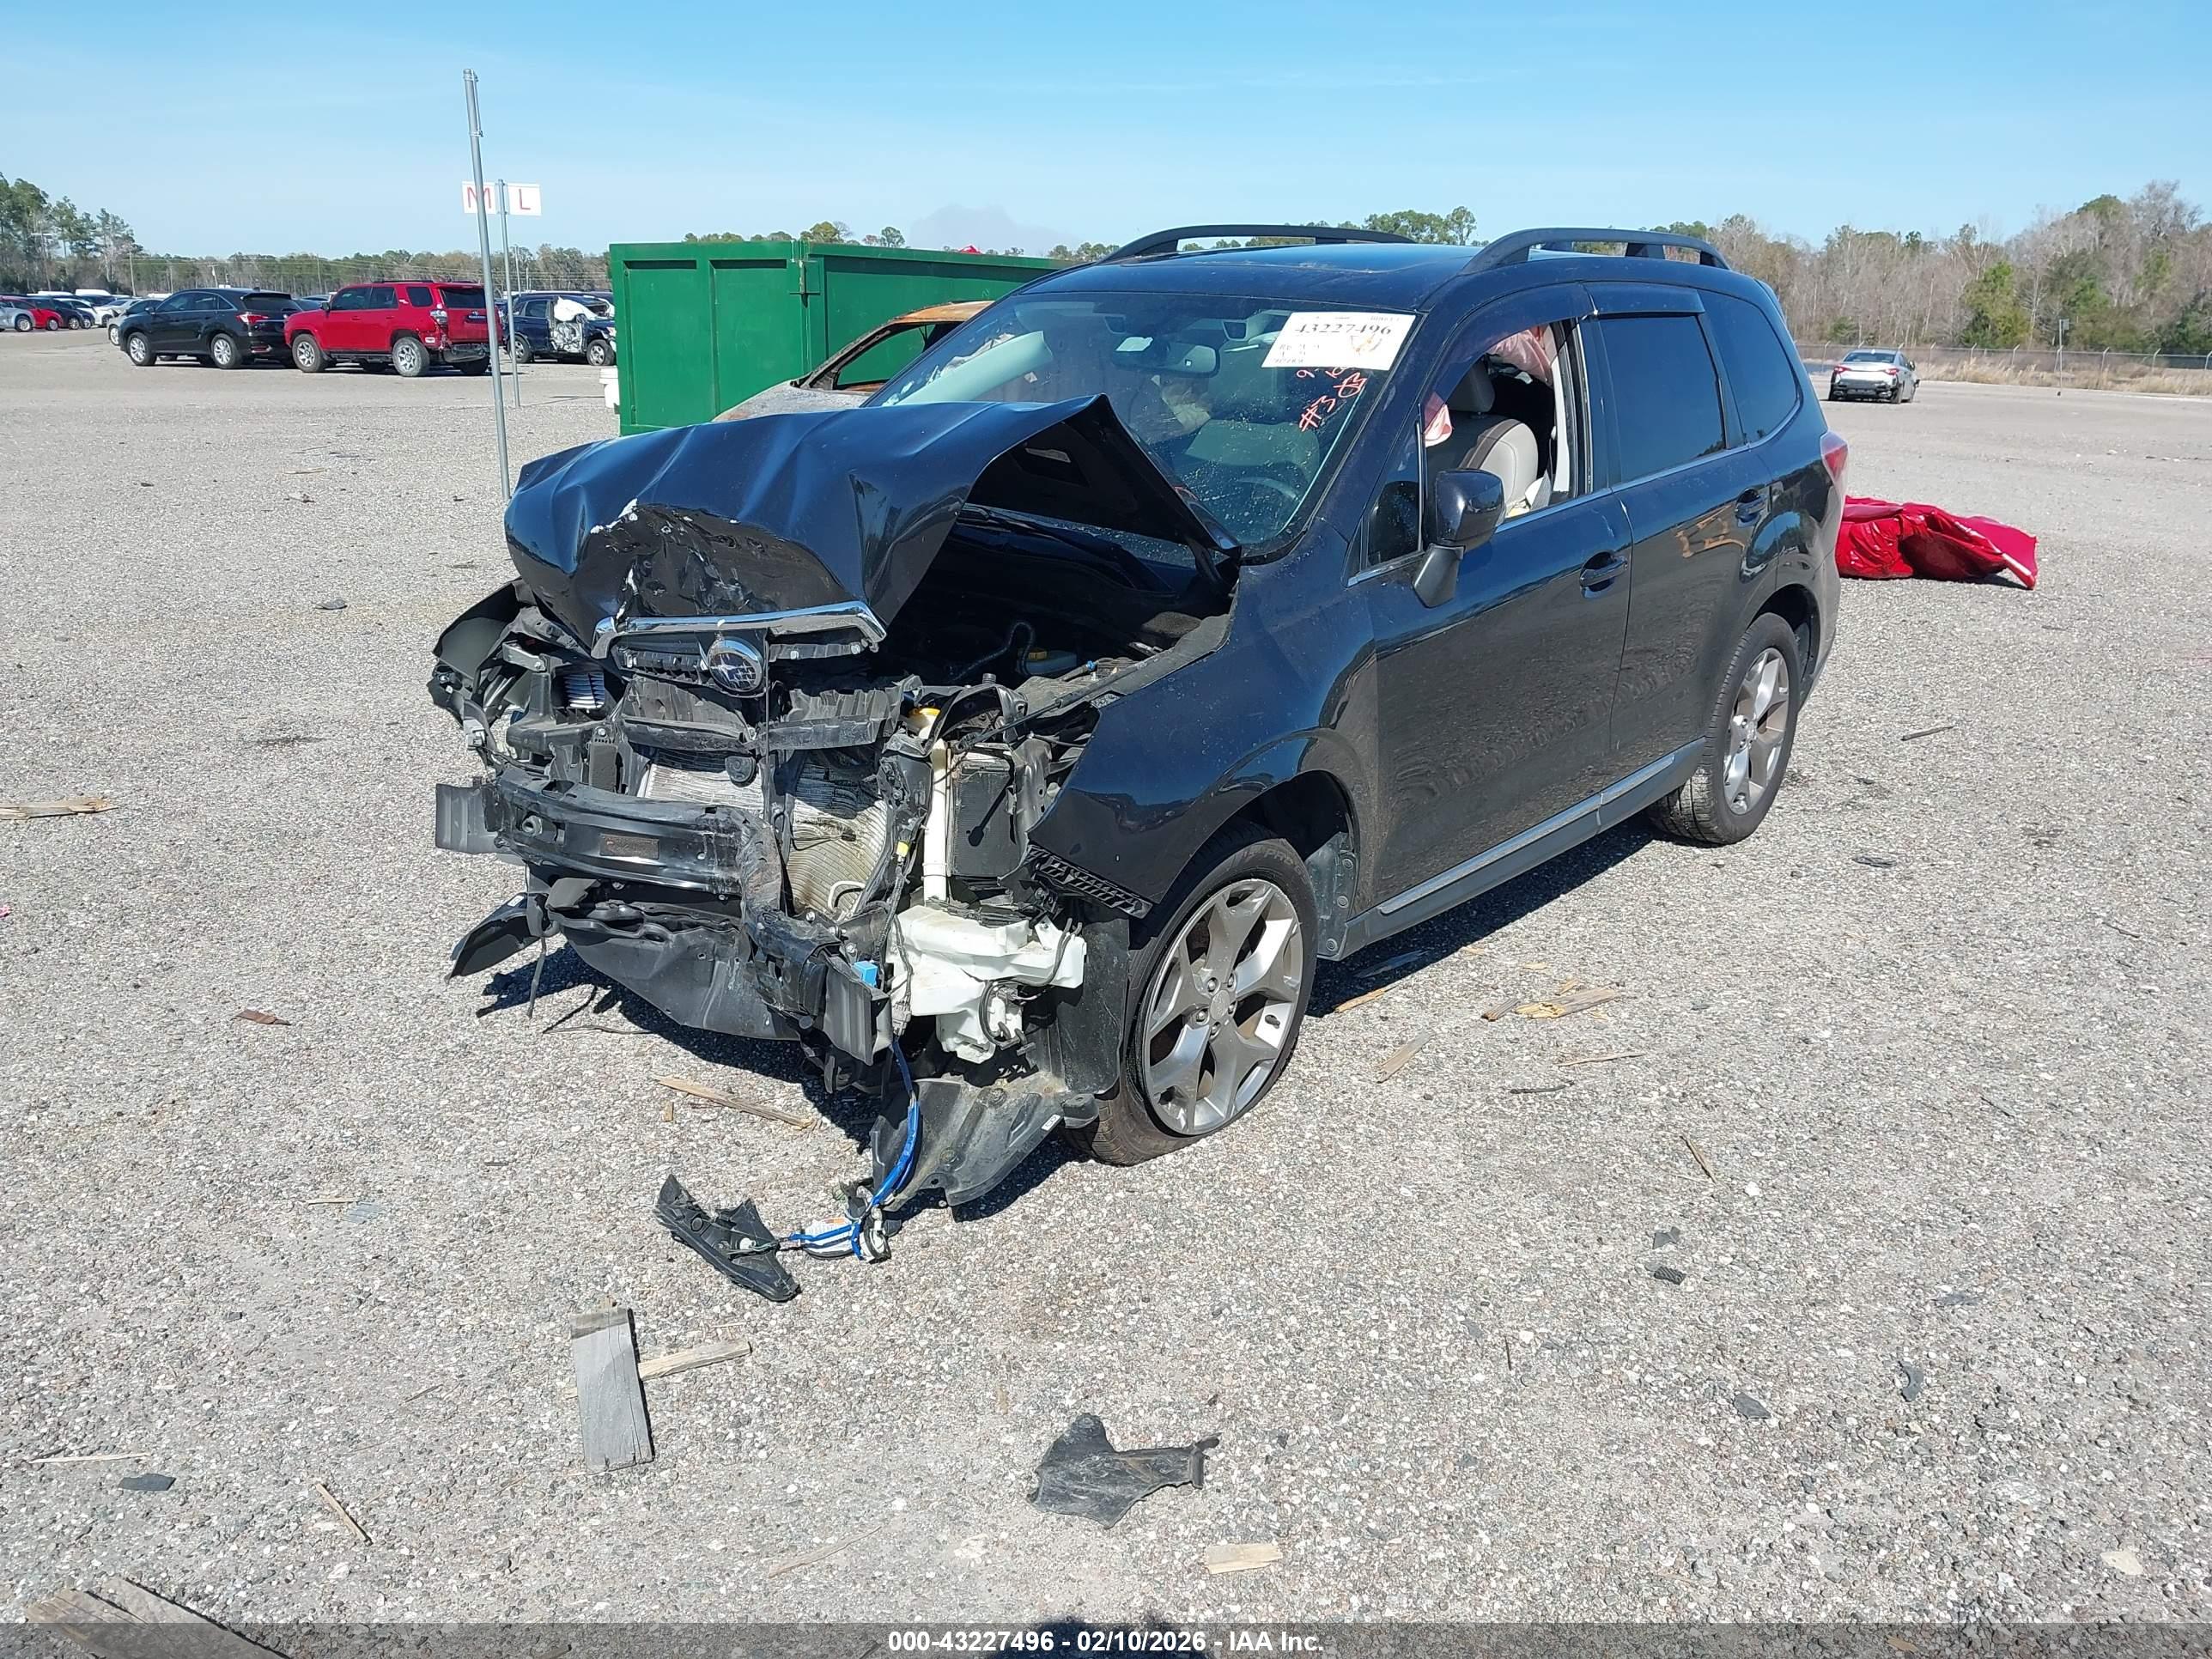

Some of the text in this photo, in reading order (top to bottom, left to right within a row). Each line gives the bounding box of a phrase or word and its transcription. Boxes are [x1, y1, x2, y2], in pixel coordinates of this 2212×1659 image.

[467, 186, 491, 209] M
[519, 189, 531, 210] L
[1294, 323, 1392, 336] 43227496
